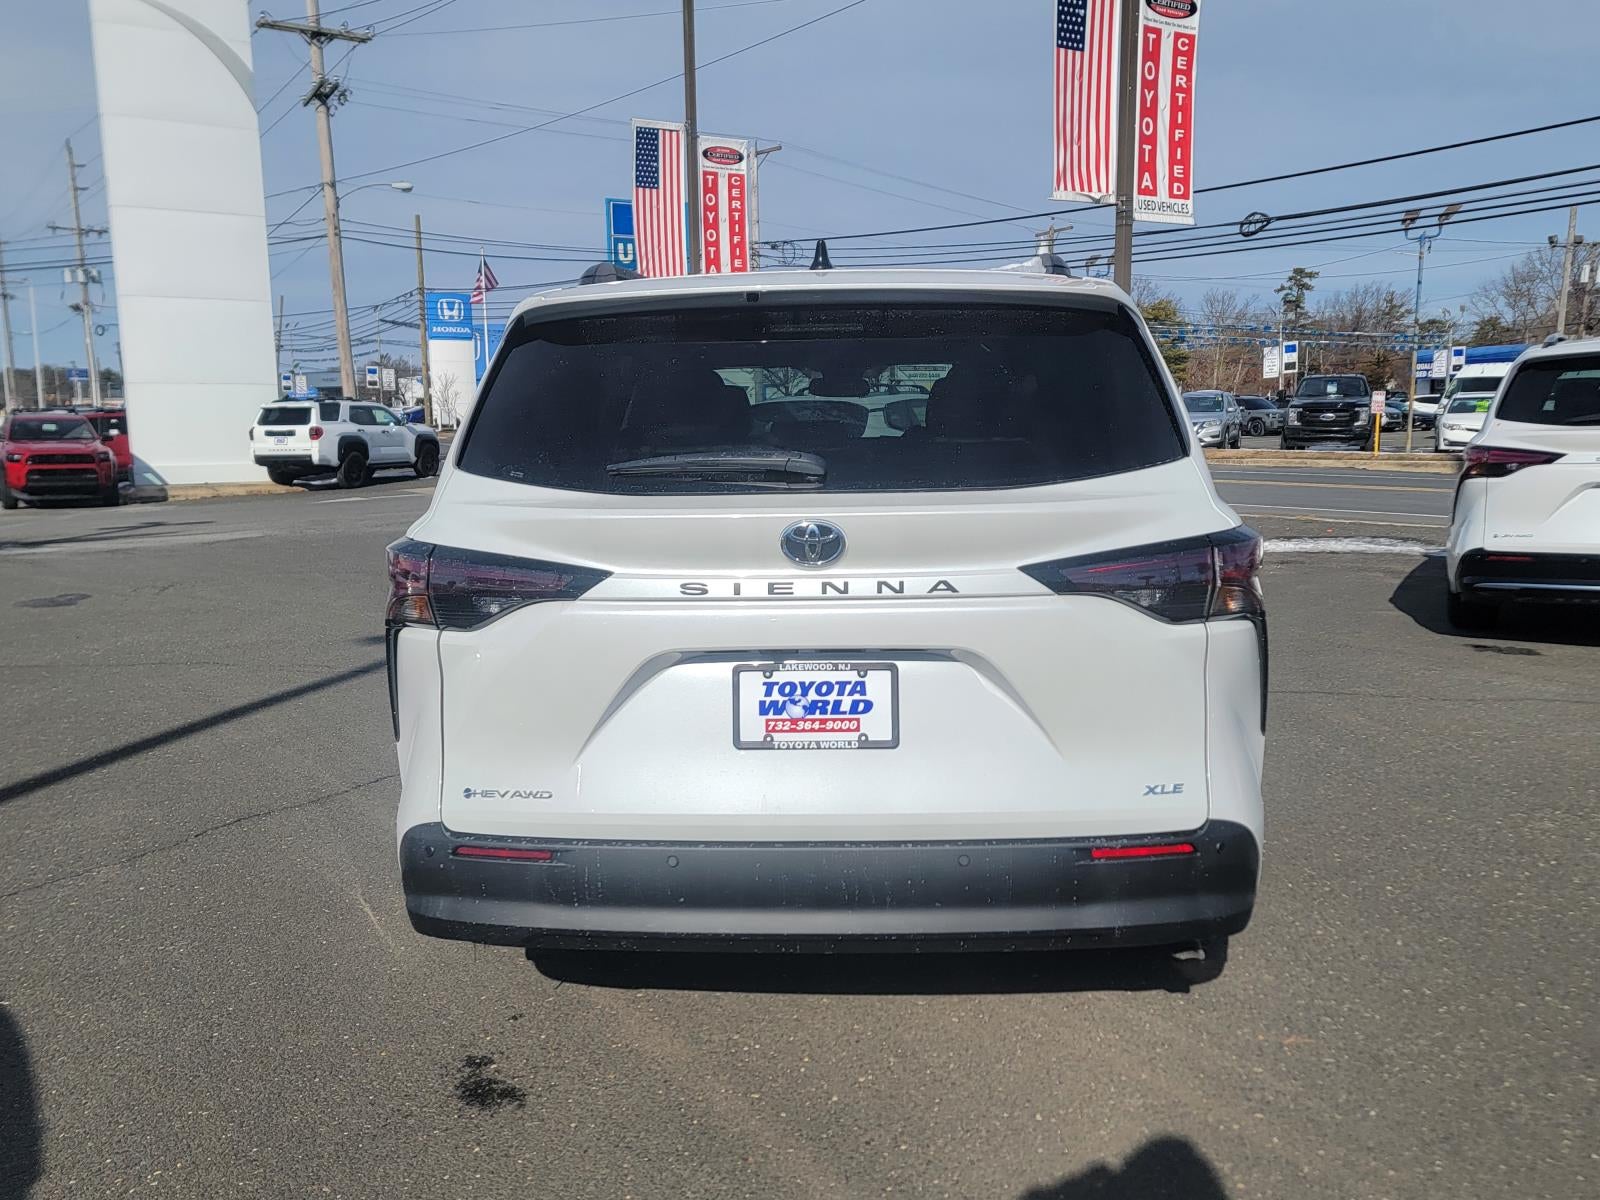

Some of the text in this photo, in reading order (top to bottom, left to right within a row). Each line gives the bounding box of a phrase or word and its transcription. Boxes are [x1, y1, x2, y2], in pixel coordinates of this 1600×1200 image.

[1141, 33, 1157, 190] TOYOTA
[1173, 37, 1190, 195] CERTIFIED
[1138, 199, 1190, 214] USED VEHICLES
[705, 175, 718, 272] TOYOTA
[731, 176, 744, 272] CERTIFIE
[679, 579, 960, 597] SIENNA
[762, 680, 867, 698] TOYOTA
[767, 720, 858, 731] 732-364-9000
[773, 741, 859, 750] TOYOTA WORLD
[1142, 782, 1185, 797] XLE
